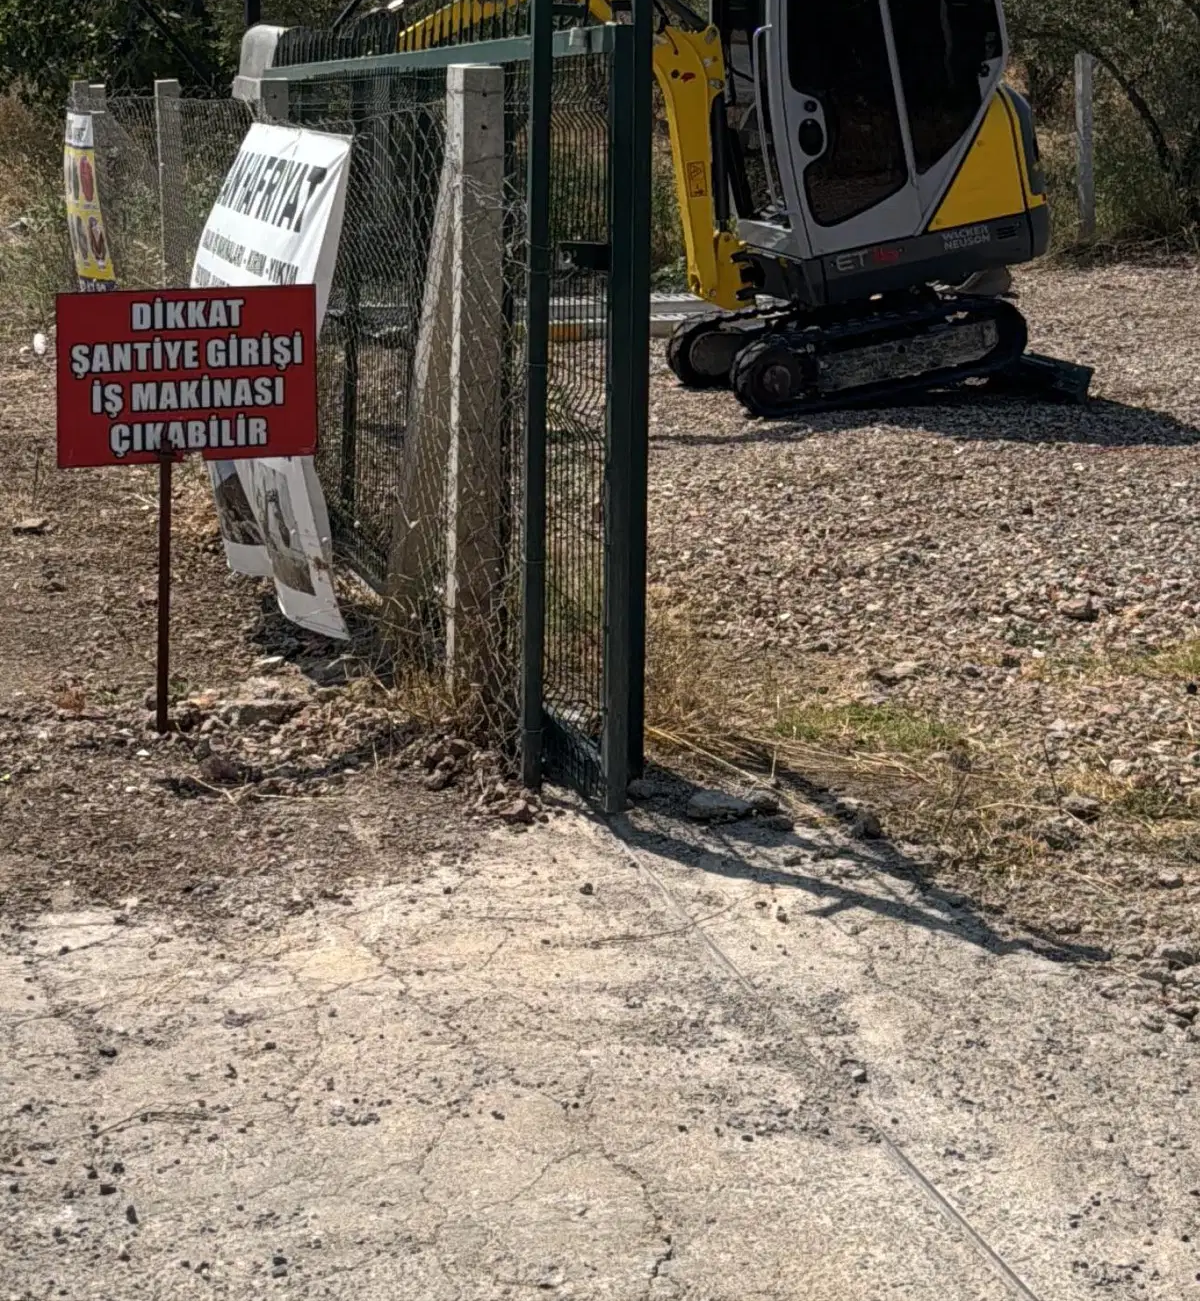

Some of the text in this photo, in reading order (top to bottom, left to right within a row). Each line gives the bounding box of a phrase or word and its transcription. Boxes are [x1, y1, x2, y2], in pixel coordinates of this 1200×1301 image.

[836, 249, 869, 272] ET
[130, 296, 245, 331] DİKKAT
[71, 331, 303, 380] ŞANTİYE GİRİŞİ
[91, 374, 285, 418] İŞ MAKİNASI
[109, 413, 268, 458] ÇIKABİLİR
